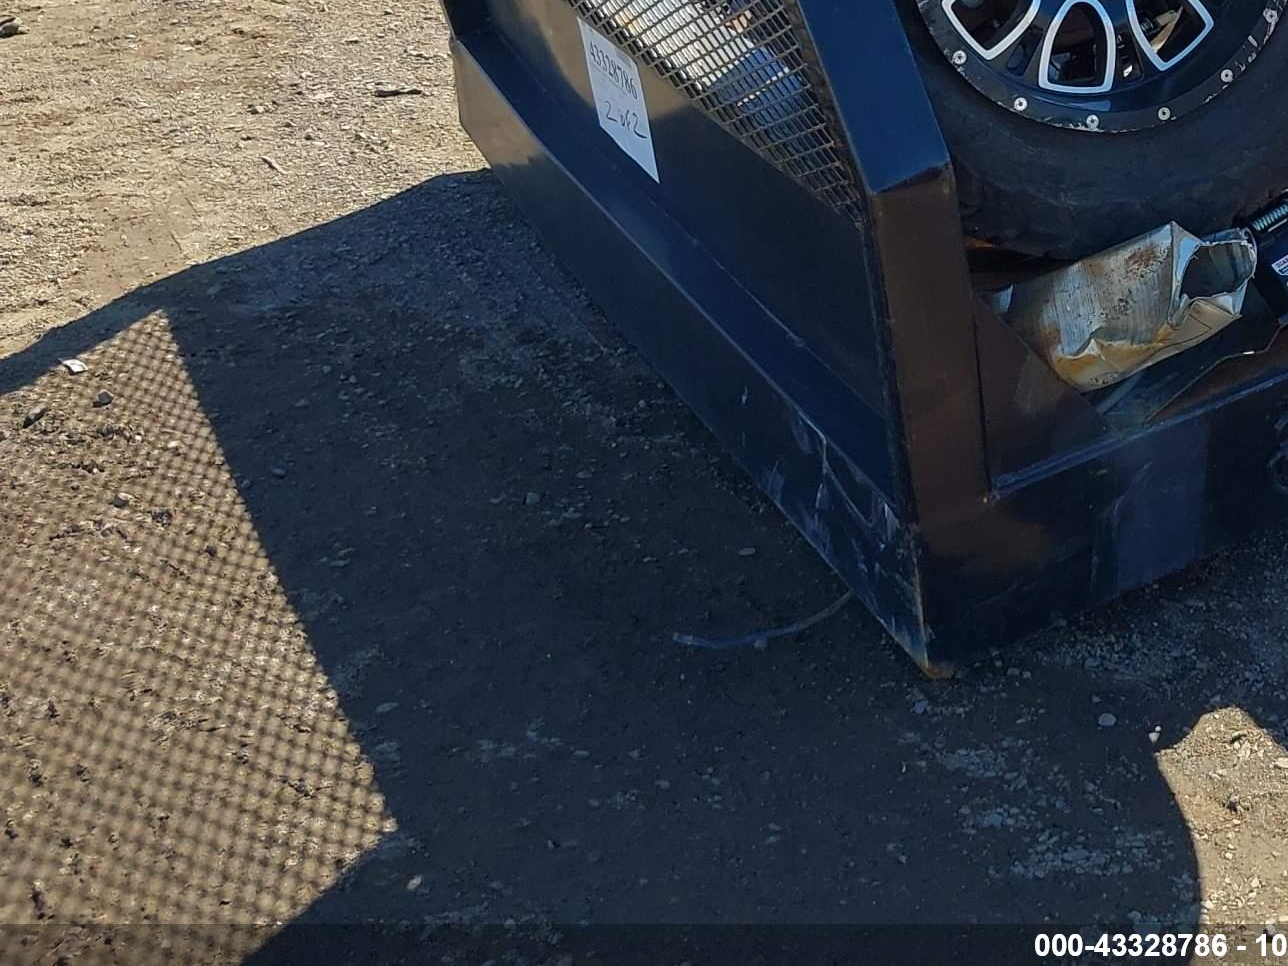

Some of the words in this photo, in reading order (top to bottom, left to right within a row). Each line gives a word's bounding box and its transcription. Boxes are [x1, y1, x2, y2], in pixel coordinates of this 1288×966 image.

[589, 41, 638, 100] 43328786
[604, 100, 617, 123] 2
[632, 112, 648, 139] 2
